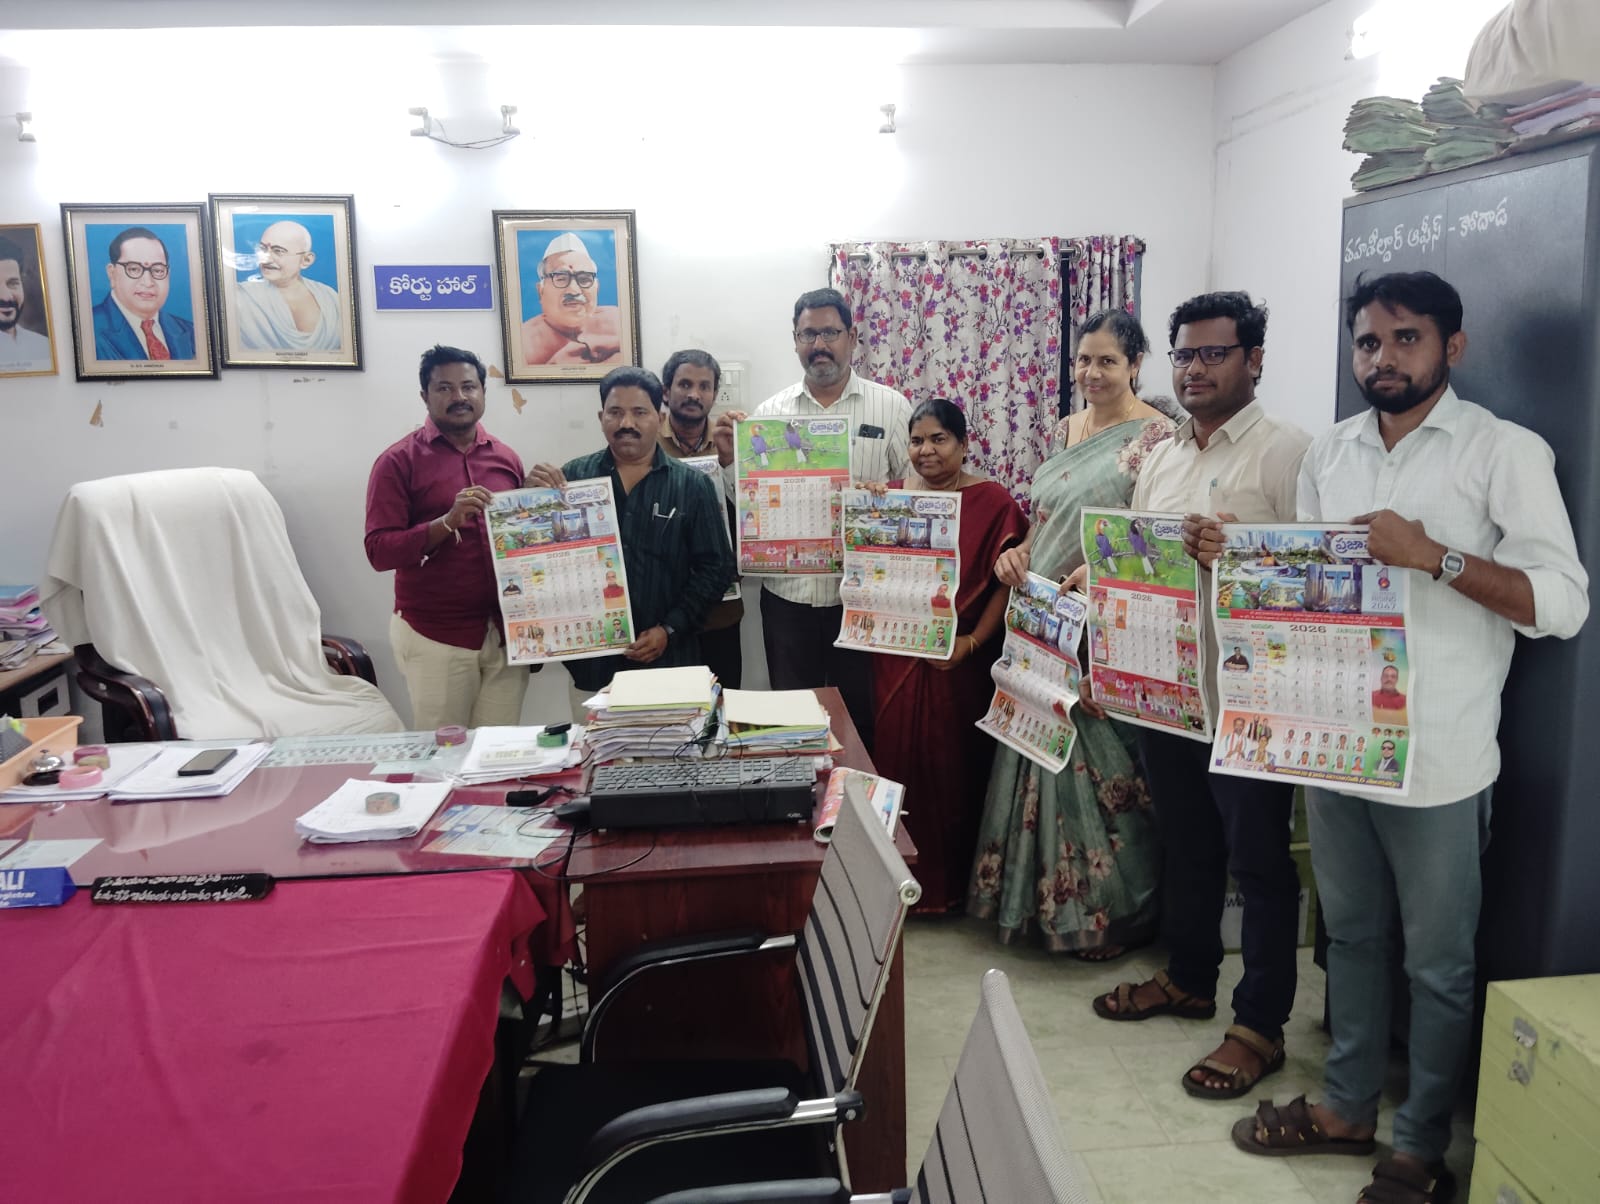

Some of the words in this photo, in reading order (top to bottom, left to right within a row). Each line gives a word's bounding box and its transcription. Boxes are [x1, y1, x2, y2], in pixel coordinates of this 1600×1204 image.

[389, 273, 433, 302] కోర్టు
[436, 274, 478, 295] హాల్
[889, 554, 912, 562] 2026
[1131, 592, 1153, 602] 2026
[1290, 624, 1327, 634] 2026
